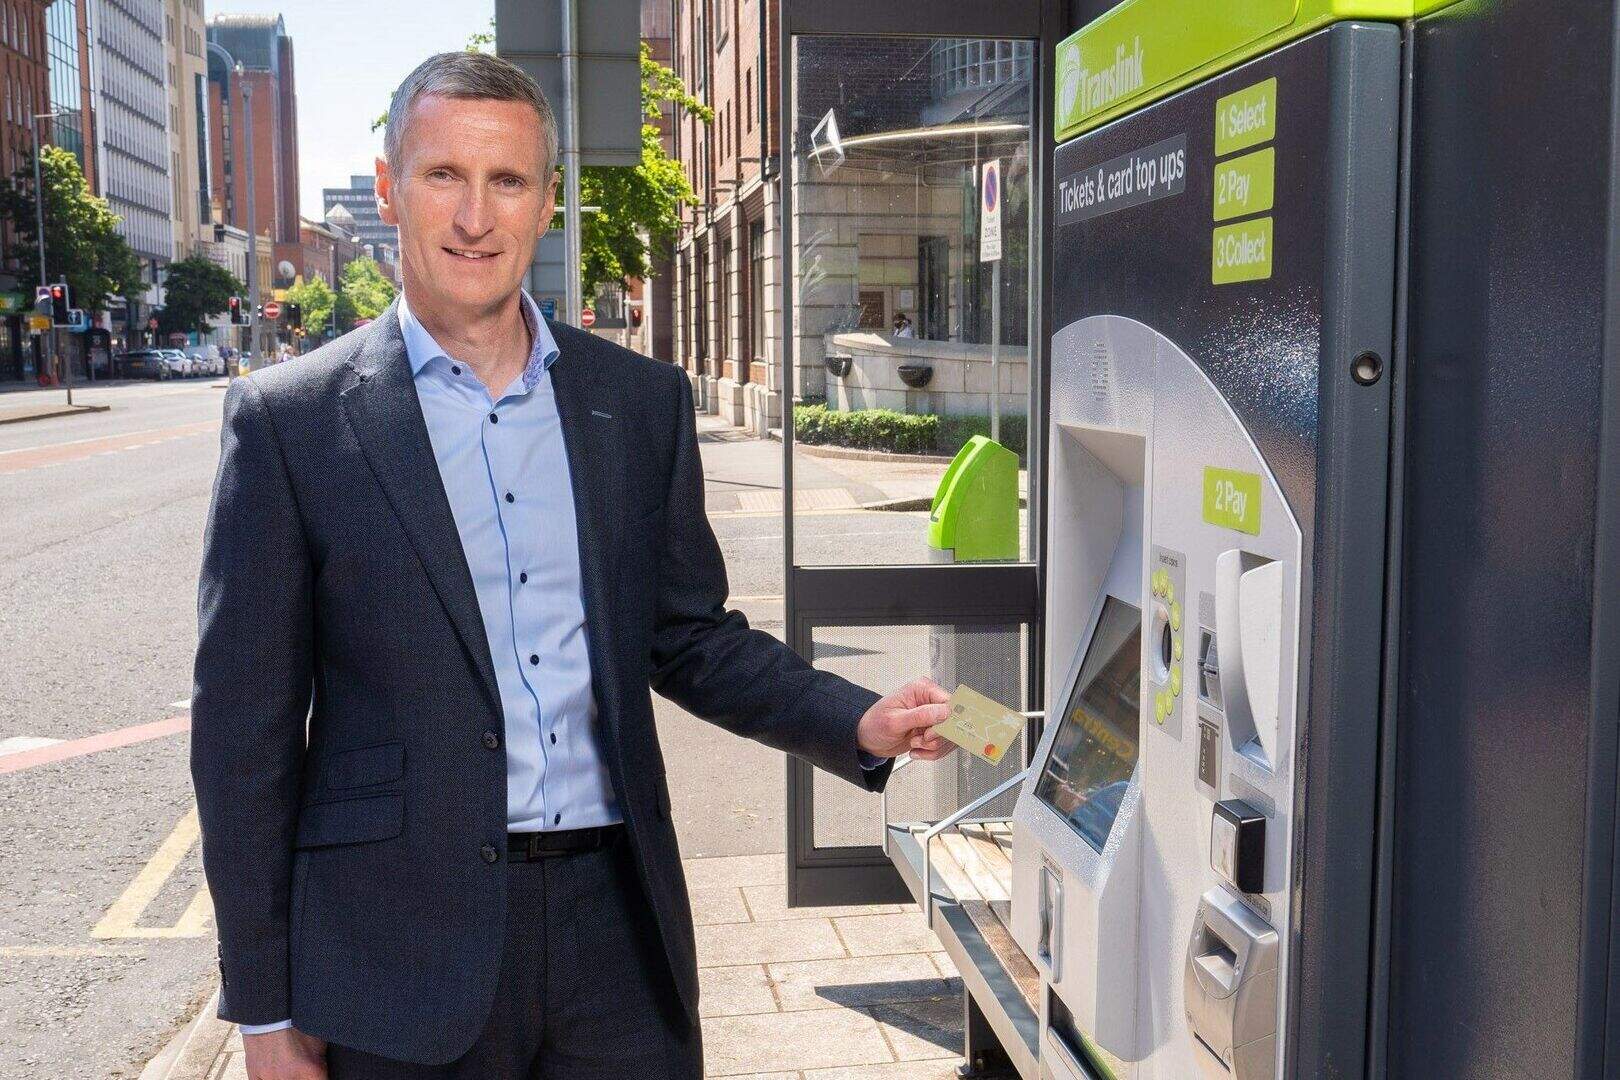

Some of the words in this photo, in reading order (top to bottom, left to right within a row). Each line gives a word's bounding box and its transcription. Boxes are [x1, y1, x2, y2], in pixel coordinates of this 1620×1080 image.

[1080, 36, 1144, 115] Translink
[1229, 96, 1266, 138] Select
[1059, 175, 1095, 214] Tickets
[1097, 168, 1105, 203] &
[1107, 157, 1133, 200] card
[1136, 157, 1157, 197] top
[1160, 149, 1185, 191] ups
[1228, 170, 1251, 208] Pay
[1225, 480, 1248, 522] Pay
